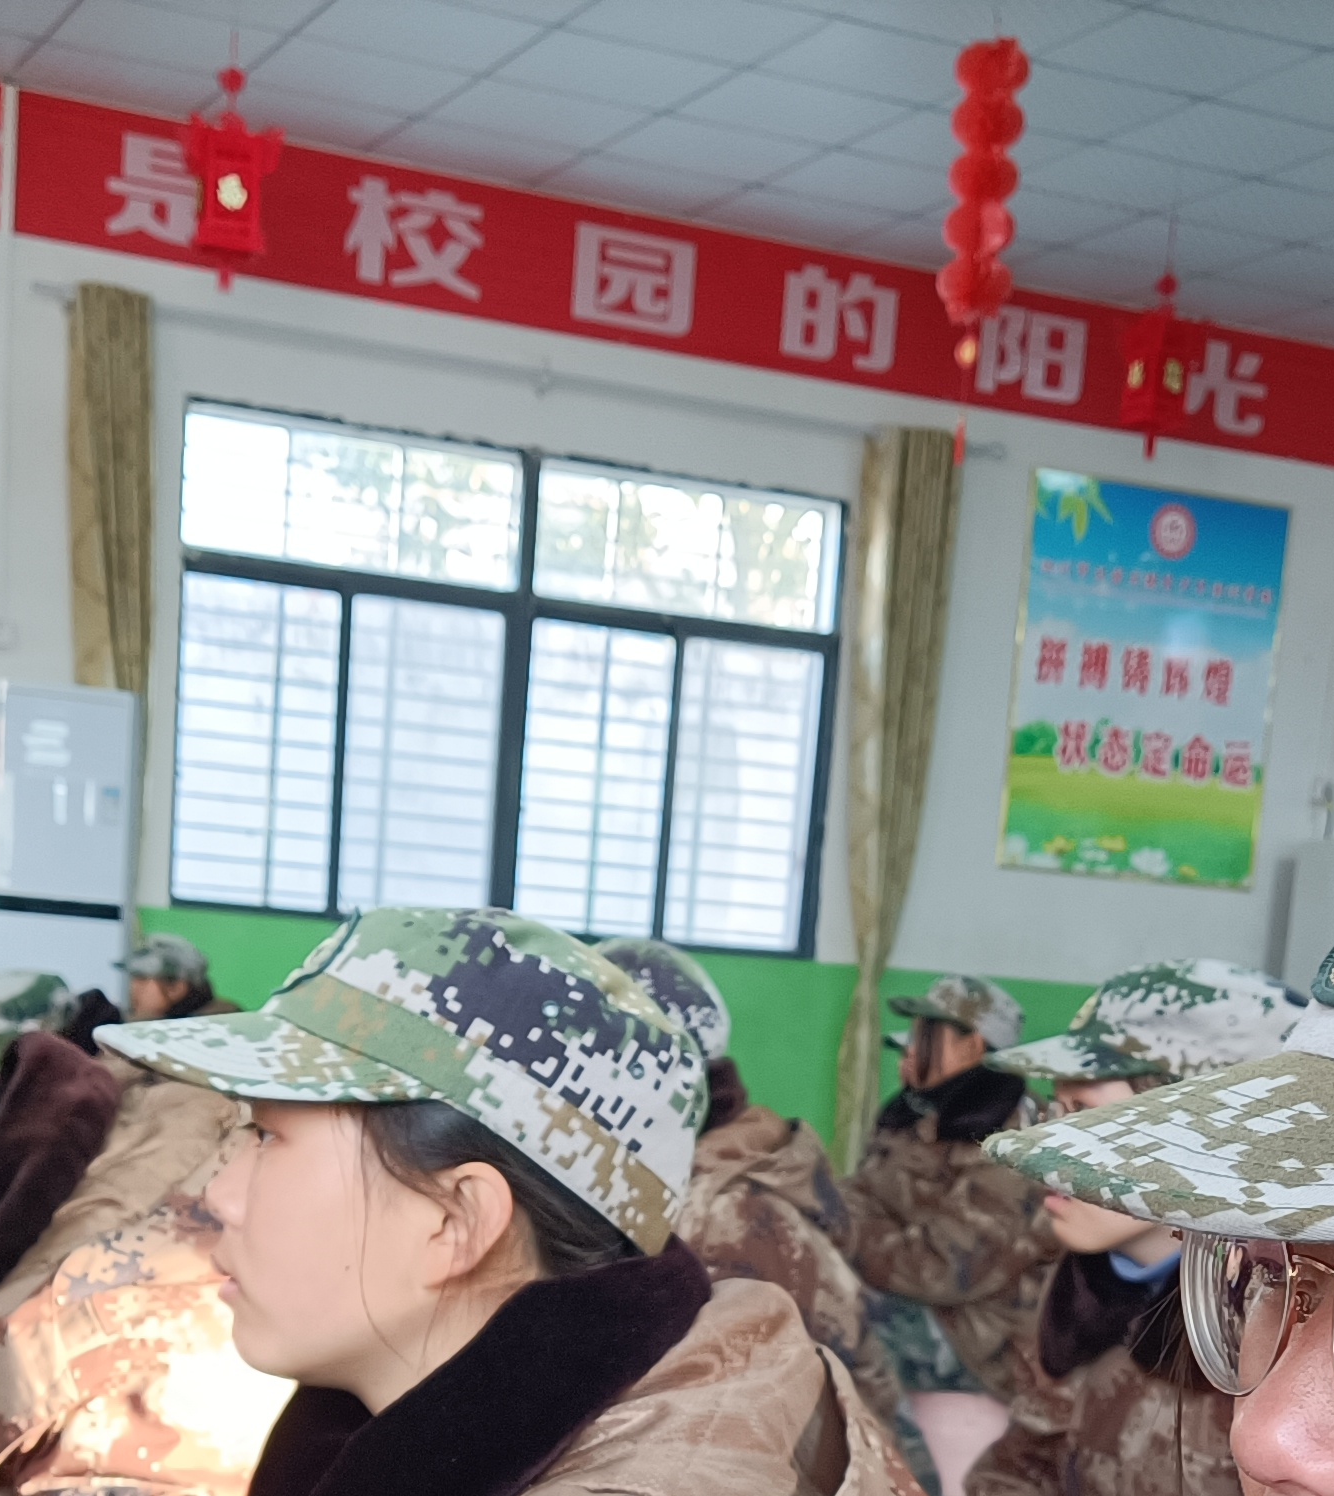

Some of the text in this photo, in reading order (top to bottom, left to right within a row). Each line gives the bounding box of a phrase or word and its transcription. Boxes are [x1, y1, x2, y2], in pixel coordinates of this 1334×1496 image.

[1058, 721, 1253, 786] 状态定命运
